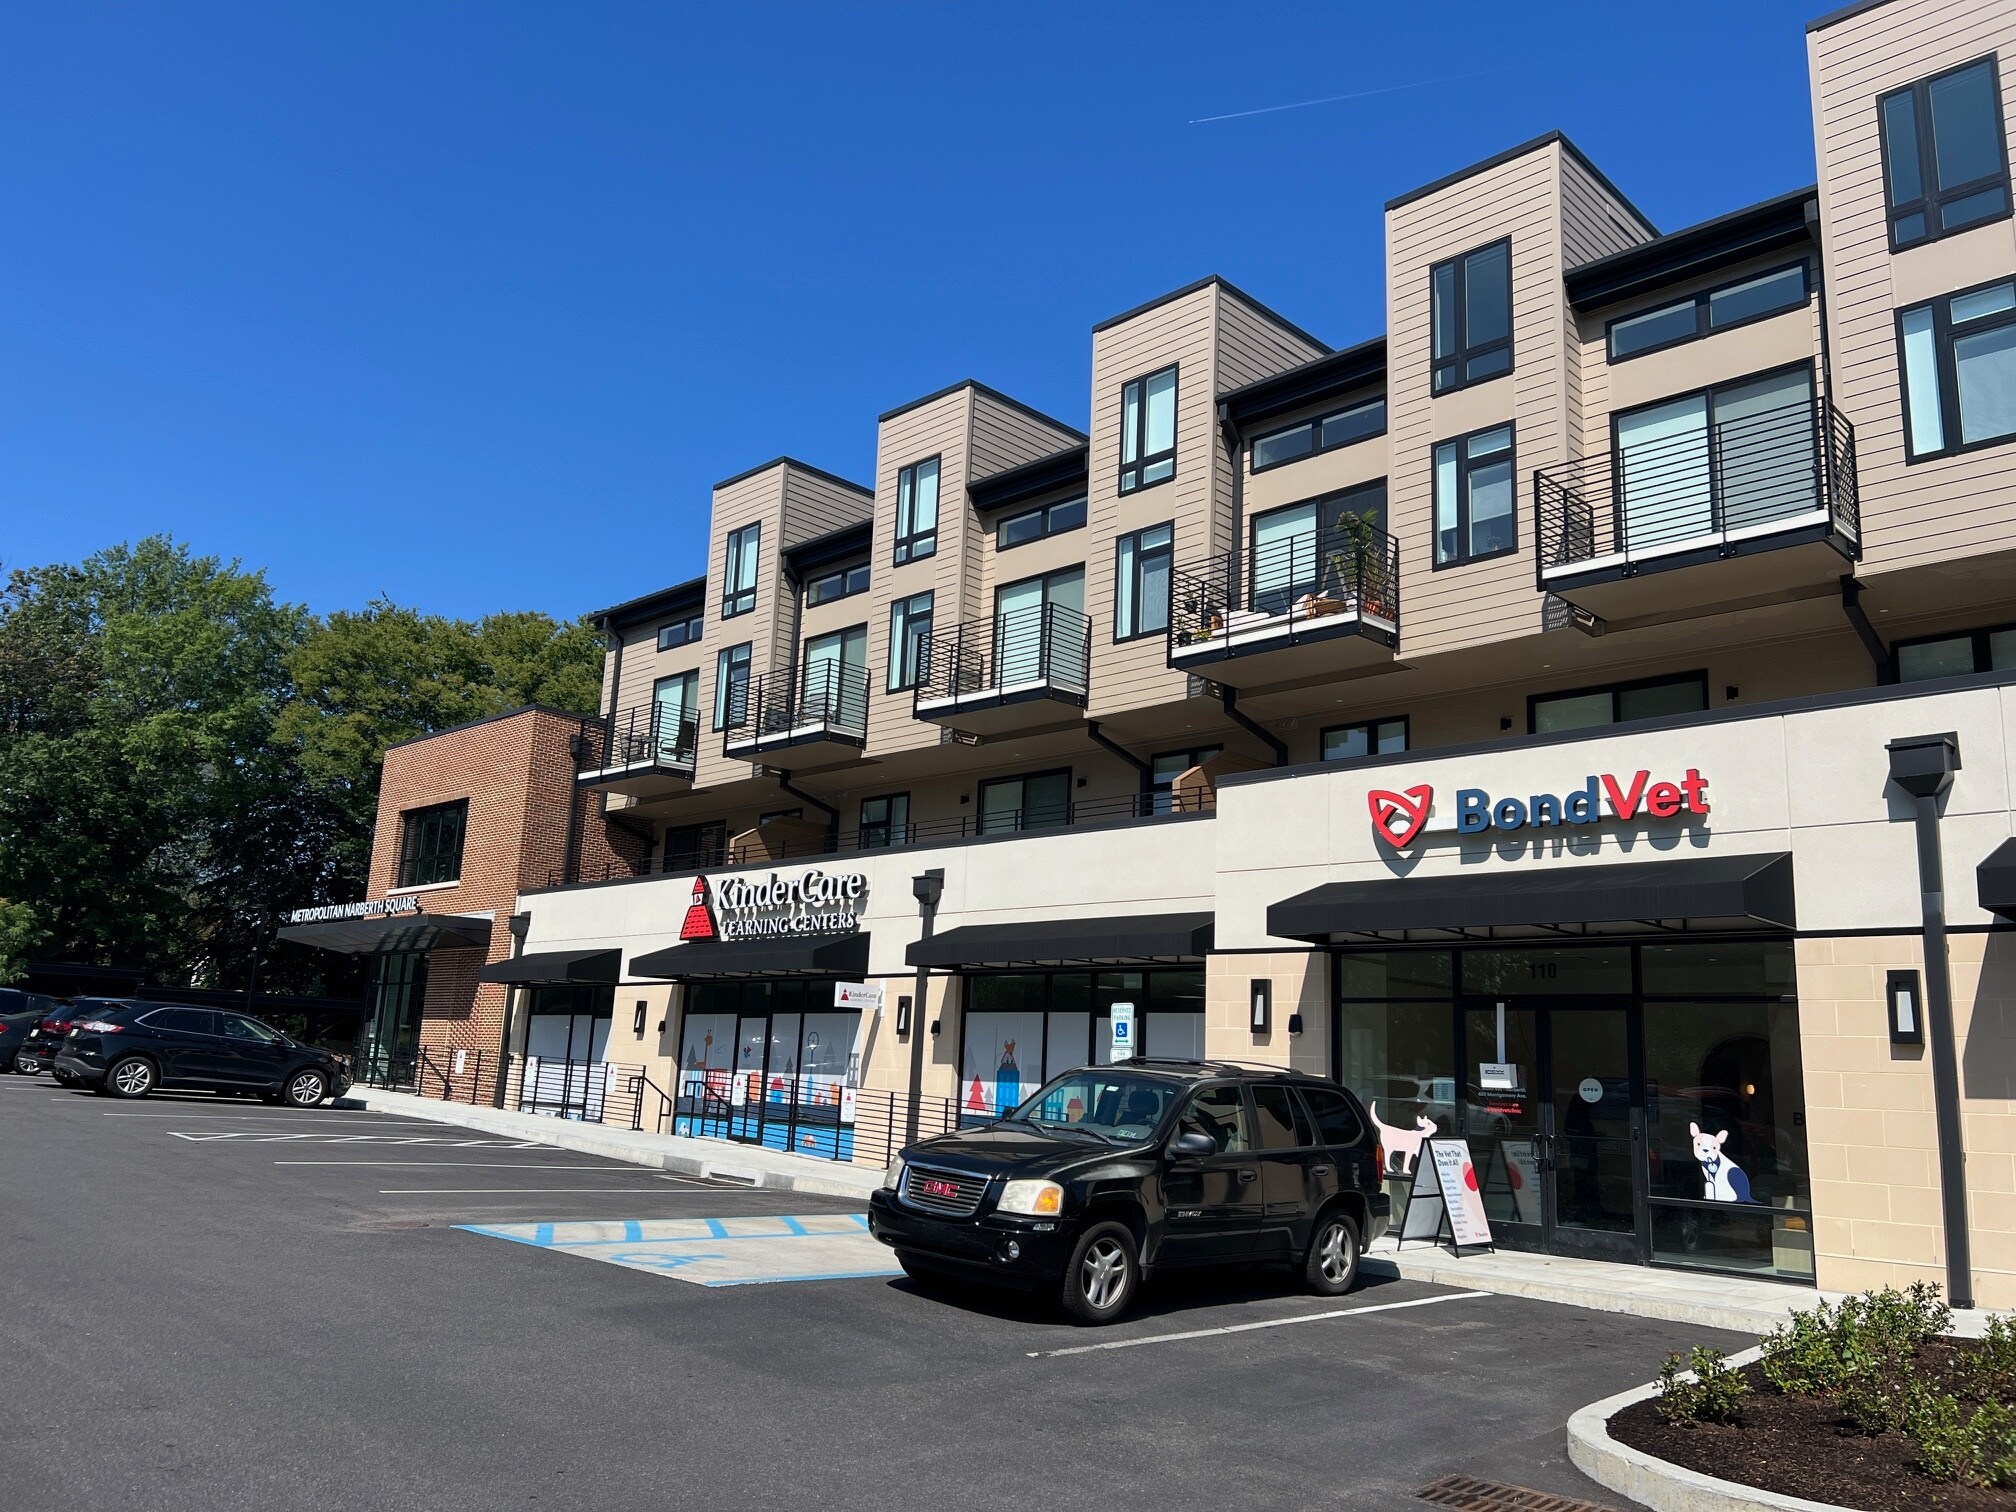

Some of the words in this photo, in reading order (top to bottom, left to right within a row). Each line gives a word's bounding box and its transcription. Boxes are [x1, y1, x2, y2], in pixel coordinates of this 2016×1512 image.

[714, 869, 864, 910] KinderCare
[290, 904, 345, 922] METROPOLITAN
[344, 900, 384, 917] NARBERTH
[384, 896, 418, 913] SQUARE
[722, 917, 794, 936] LEARNING
[793, 911, 856, 932] CENTERS
[1528, 962, 1557, 979] 110
[1435, 1150, 1444, 1158] The
[1451, 1150, 1462, 1158] That
[1438, 1159, 1449, 1167] Does
[923, 1180, 961, 1198] GMC
